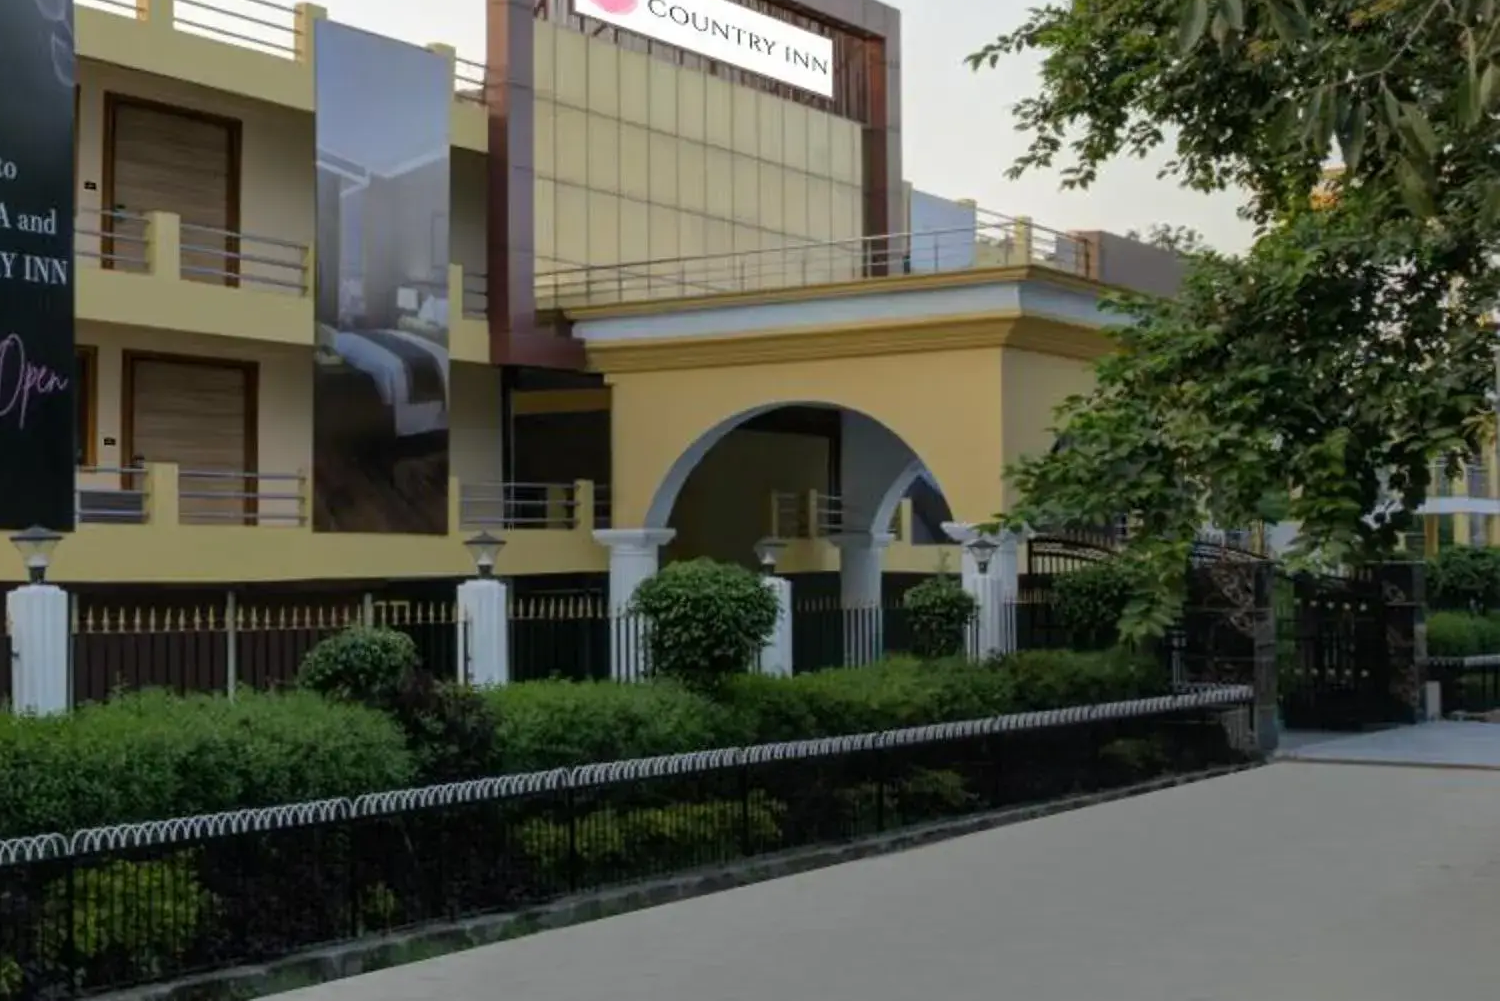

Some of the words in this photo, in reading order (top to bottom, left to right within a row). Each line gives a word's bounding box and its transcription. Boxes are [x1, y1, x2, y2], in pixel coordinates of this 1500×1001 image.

[784, 46, 828, 75] INN
[17, 207, 57, 235] and
[23, 254, 68, 285] INN
